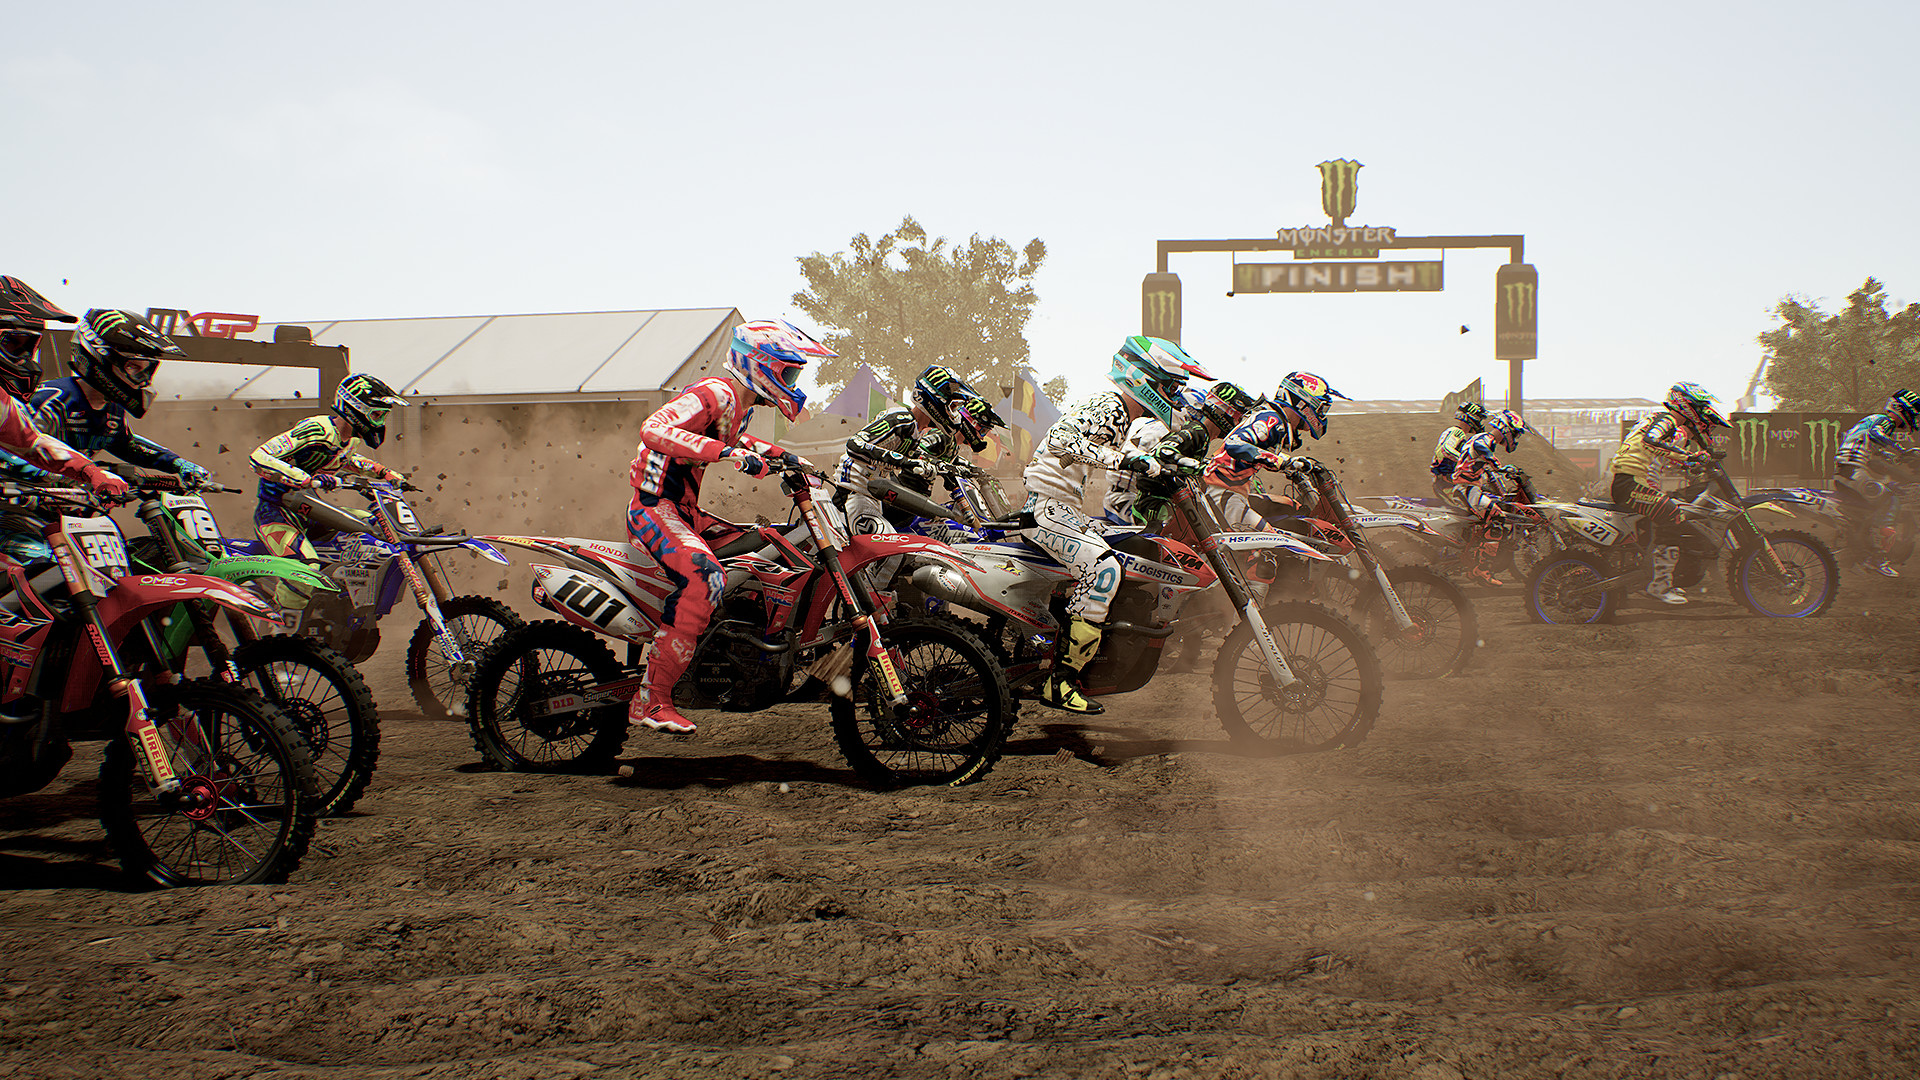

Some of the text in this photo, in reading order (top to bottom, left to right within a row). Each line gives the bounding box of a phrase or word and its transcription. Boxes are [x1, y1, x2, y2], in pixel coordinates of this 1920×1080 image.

[1277, 226, 1395, 246] MONSTER
[1296, 248, 1379, 258] ENERGY
[1262, 264, 1416, 287] FINISH
[146, 308, 260, 340] MXGP
[1140, 386, 1170, 415] LEOPARD
[177, 509, 221, 540] 18
[1582, 521, 1612, 543] 321
[870, 534, 910, 543] OMEC
[1229, 536, 1251, 544] HSF
[589, 543, 630, 560] HONDA
[1162, 551, 1204, 571] KTM
[1112, 550, 1184, 585] SF LOGISTICS
[140, 575, 188, 586] OMEC
[552, 574, 628, 629] 101
[1262, 630, 1287, 671] DUNLOP
[880, 652, 904, 693] PIRELLI
[583, 683, 640, 703] Supersprox
[142, 728, 173, 778] PIRELLI
